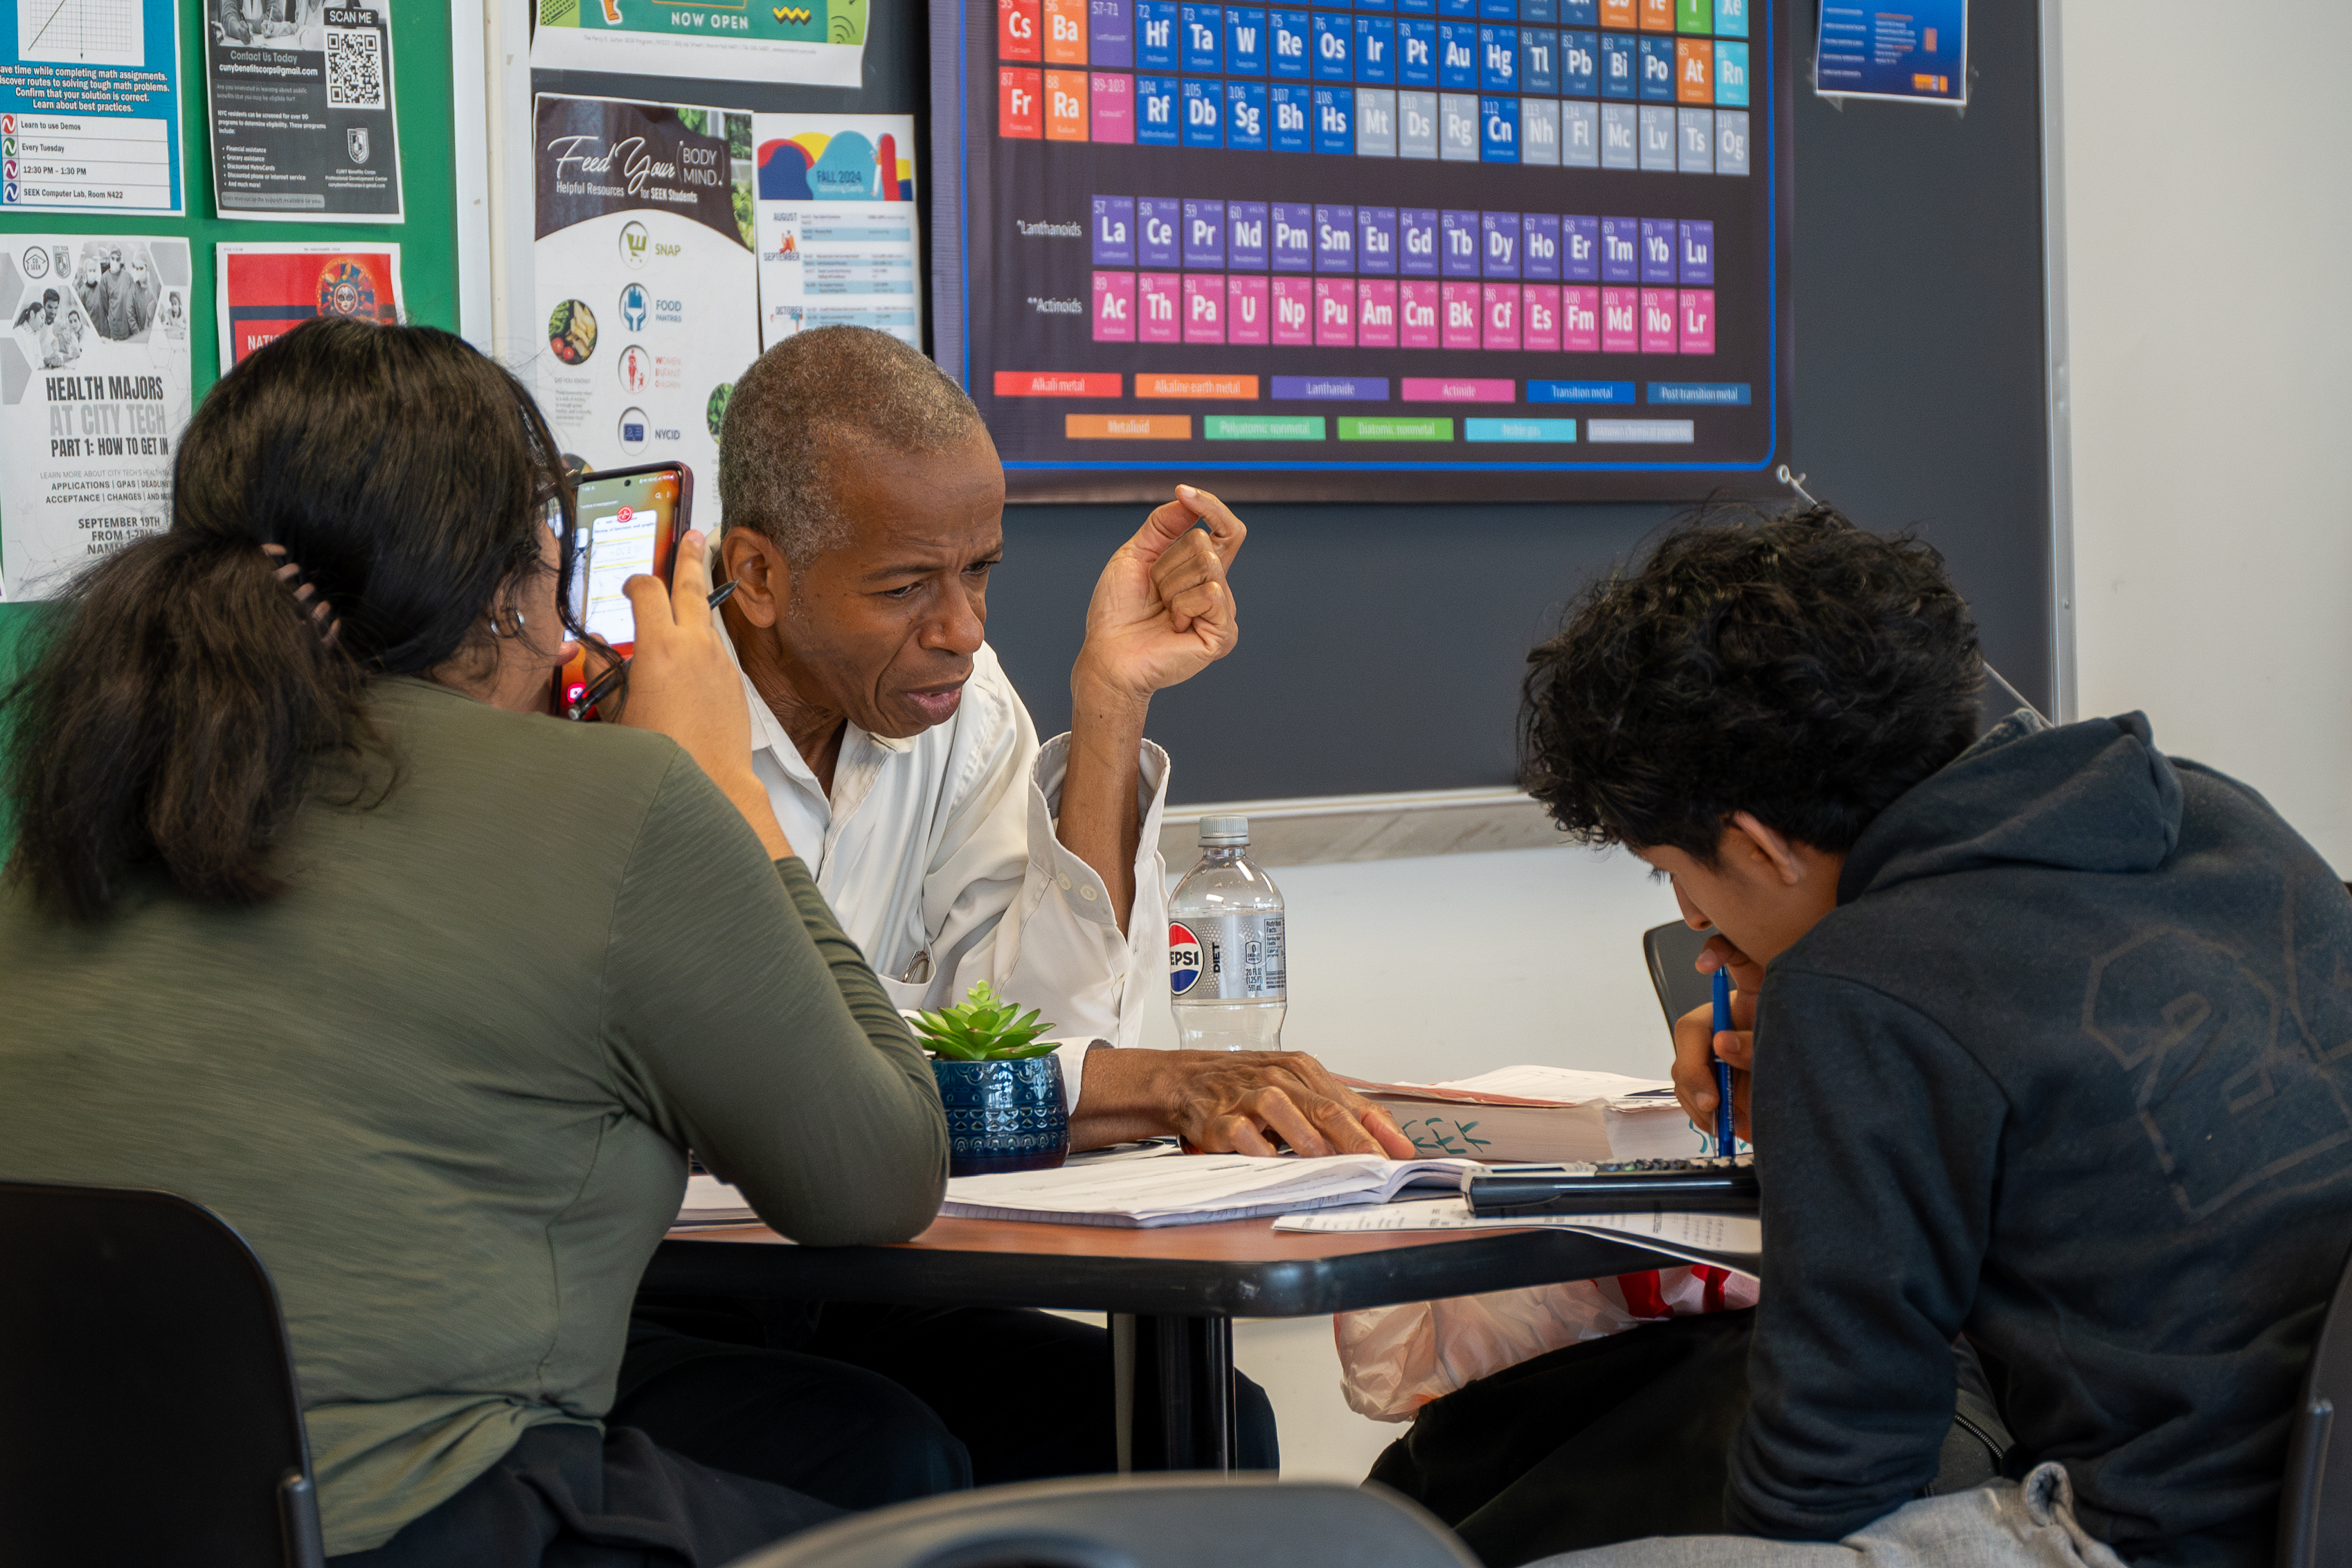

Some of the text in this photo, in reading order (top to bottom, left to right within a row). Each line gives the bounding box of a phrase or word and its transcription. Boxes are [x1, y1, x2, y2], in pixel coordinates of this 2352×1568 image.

[330, 10, 371, 24] SCAN ME
[672, 12, 748, 29] NOW OPEN
[1009, 11, 1032, 39] Cs
[1052, 15, 1078, 42] Ba
[1146, 19, 1170, 47] Hf
[1190, 23, 1214, 51] Ta
[1236, 26, 1256, 53] W
[1277, 29, 1302, 57] Re
[1320, 32, 1346, 60] Os
[231, 50, 297, 65] Contact Us Today
[1367, 35, 1384, 62] Ir
[1407, 38, 1428, 64] Pt
[1446, 41, 1471, 68] Au
[1487, 44, 1513, 77] Hg
[1530, 46, 1550, 73] Tl
[1568, 48, 1592, 75] Pb
[15, 64, 32, 75] time
[33, 65, 54, 76] while
[55, 67, 97, 80] completing
[98, 69, 118, 78] math
[119, 70, 168, 82] assignments.
[219, 64, 318, 76] cunybenefitscorps@gmail.com
[1610, 51, 1628, 78] Bi
[1646, 55, 1669, 81] Po
[1685, 58, 1704, 83] At
[1721, 60, 1743, 85] Rn
[15, 87, 150, 102] Confirm that your solution is correct.
[27, 78, 51, 87] routes
[53, 78, 60, 87] to
[62, 79, 89, 90] solving
[90, 79, 111, 91] tough
[113, 81, 132, 90] math
[134, 82, 170, 93] problems.
[33, 99, 134, 113] Learn about best practices.
[1012, 89, 1032, 116] Fr
[1054, 91, 1079, 118] Ra
[1147, 95, 1170, 123] Rf
[1190, 98, 1217, 126] Db
[21, 120, 38, 129] Learn
[1235, 100, 1260, 136] Sg
[1277, 102, 1304, 130] Bh
[1322, 106, 1347, 133] Hs
[1488, 115, 1512, 142] Cn
[22, 143, 64, 153] Every Tuesday
[683, 147, 717, 165] BODY
[548, 136, 675, 195] Feed Your
[816, 170, 862, 183] FALL 2024
[42, 190, 71, 198] Computer
[556, 181, 698, 204] Helpful Resources for SEEK Students
[773, 213, 798, 221] AUGUST
[1102, 216, 1126, 243] La
[1147, 217, 1172, 245] Ce
[1193, 219, 1216, 246] Pr
[1235, 220, 1262, 248] Nd
[1276, 223, 1308, 249] Pm
[1320, 224, 1350, 251] Sm
[1366, 226, 1389, 252] Eu
[1407, 227, 1432, 254] Gd
[1448, 228, 1473, 255] Tb
[655, 244, 681, 256] SNAP
[764, 252, 800, 261] SEPTEMBER
[1490, 231, 1514, 263] Dy
[1529, 233, 1554, 258] Ho
[1572, 234, 1591, 260] Er
[1606, 235, 1633, 261] Tm
[1648, 236, 1669, 262] Yb
[1687, 239, 1707, 264] Lu
[655, 314, 682, 323] PANTRIES
[656, 300, 682, 312] FOOD
[775, 305, 803, 316] OCTOBER
[248, 334, 280, 350] NATI
[46, 376, 163, 401] HEALTH MAJORS
[1032, 377, 1085, 393] Alkali metal
[1552, 384, 1613, 399] Transition metal
[50, 404, 166, 436] AT CITY TECH
[51, 437, 169, 457] PART 1: HOW TO GET IN
[655, 429, 680, 440] NYCID
[46, 492, 159, 504] ACCEPTANCE CHANGES AND
[51, 480, 110, 491] APPLICATIONS
[141, 480, 172, 488] DEADLINE
[78, 517, 160, 529] SEPTEMBER 19TH
[91, 530, 123, 541] FROM
[1170, 951, 1199, 966] EPSI
[1212, 941, 1221, 973] DIET
[1252, 944, 1256, 953] 0
